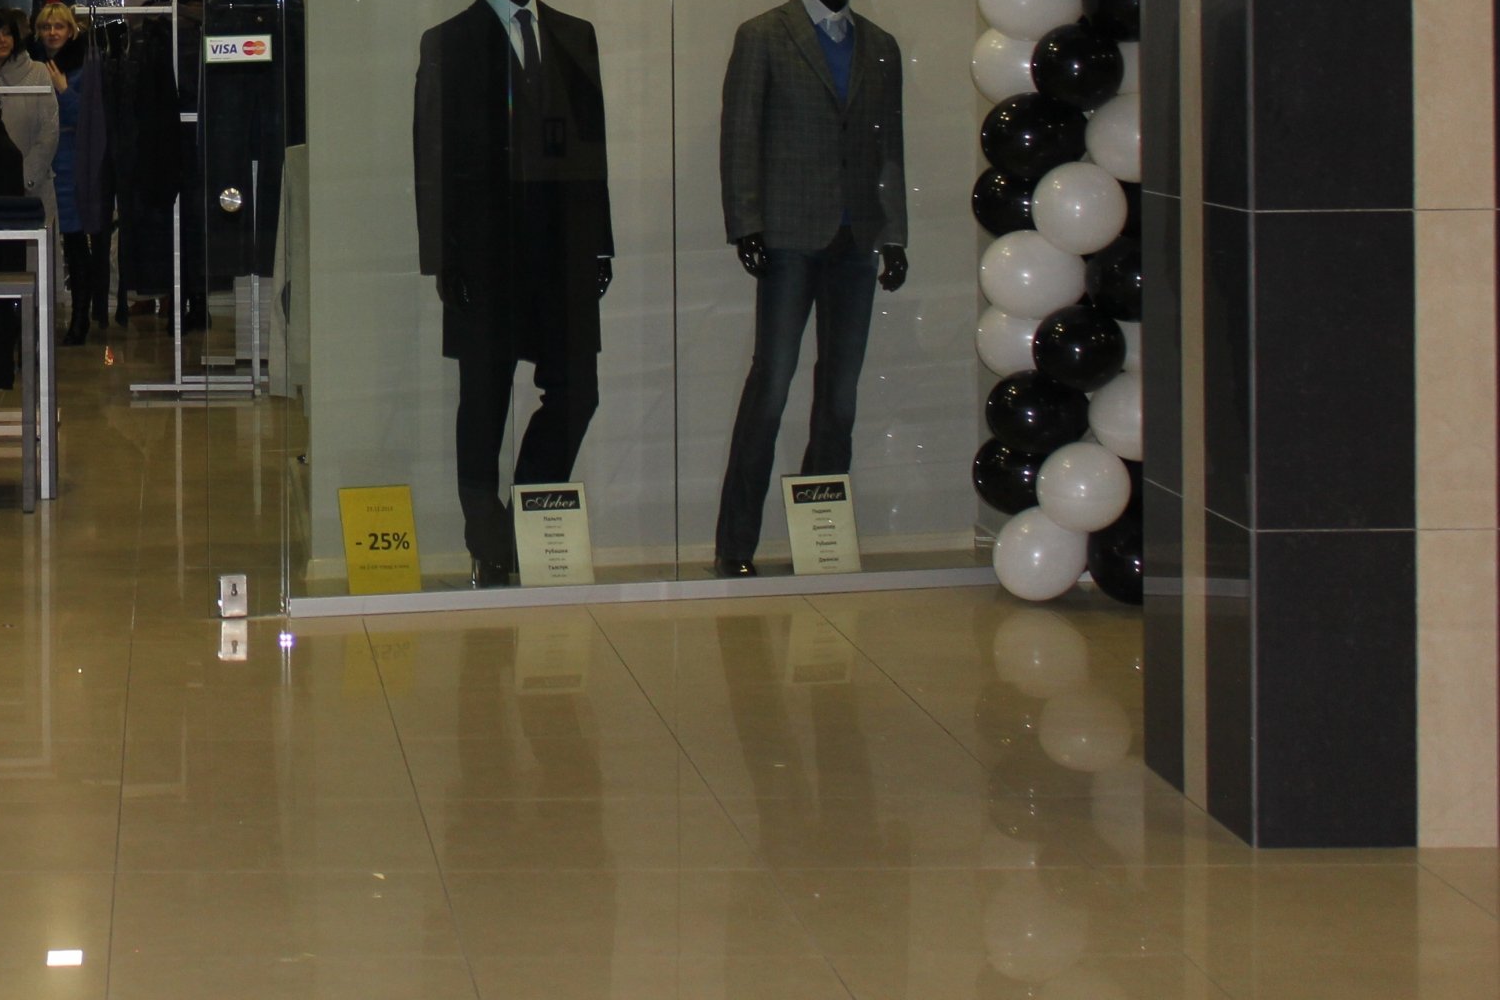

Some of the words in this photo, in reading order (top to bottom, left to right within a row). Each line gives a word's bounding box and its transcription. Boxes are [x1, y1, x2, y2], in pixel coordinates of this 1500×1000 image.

[211, 44, 238, 54] VISA
[525, 493, 576, 509] Arber
[796, 485, 843, 501] Arber
